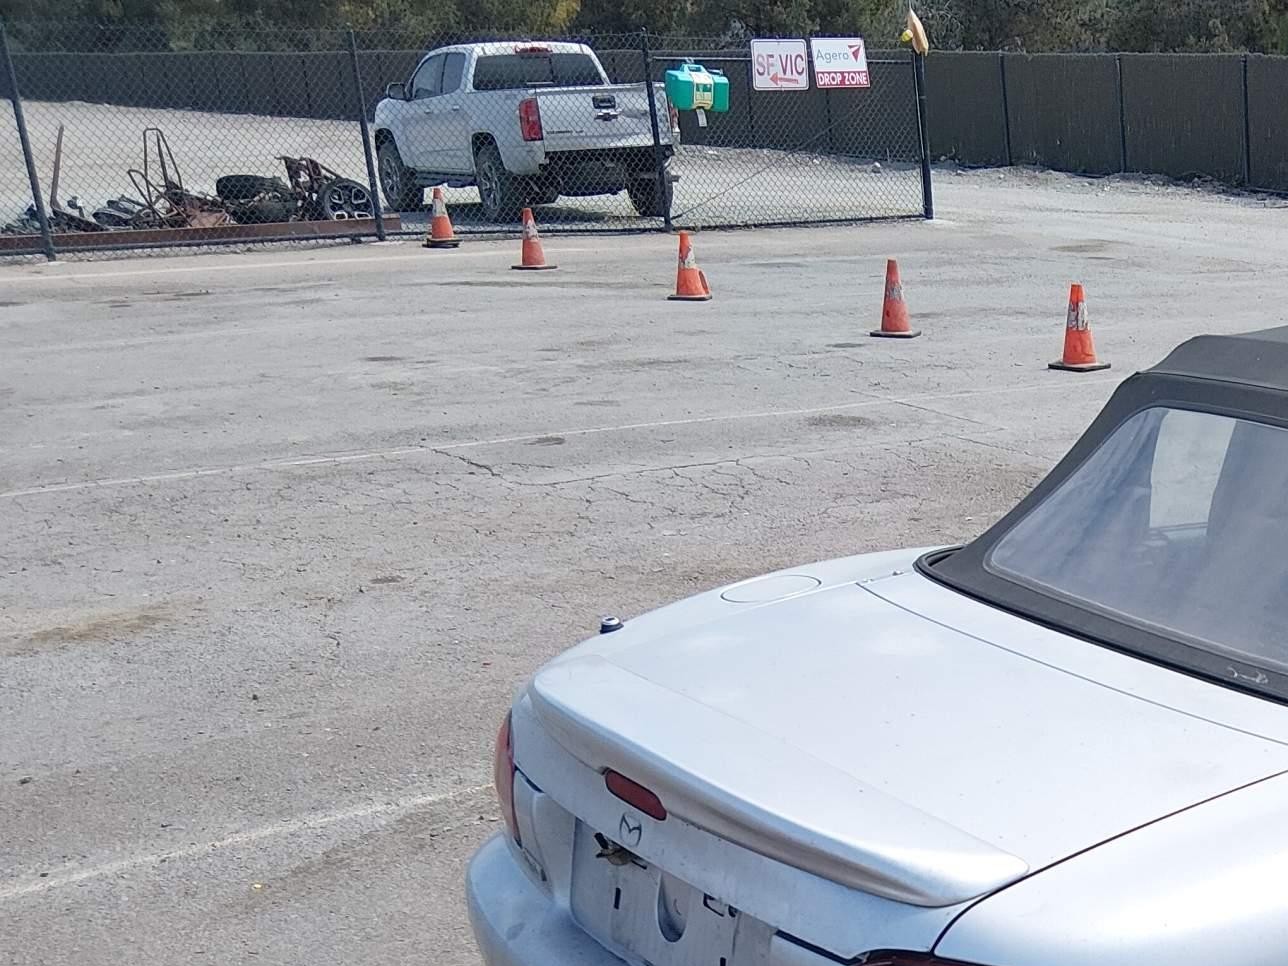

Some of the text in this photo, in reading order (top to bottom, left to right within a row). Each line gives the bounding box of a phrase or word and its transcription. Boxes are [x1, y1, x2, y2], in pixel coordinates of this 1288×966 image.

[816, 49, 849, 63] Agero
[756, 53, 805, 76] SF VIC
[818, 71, 868, 85] DROP ZONE
